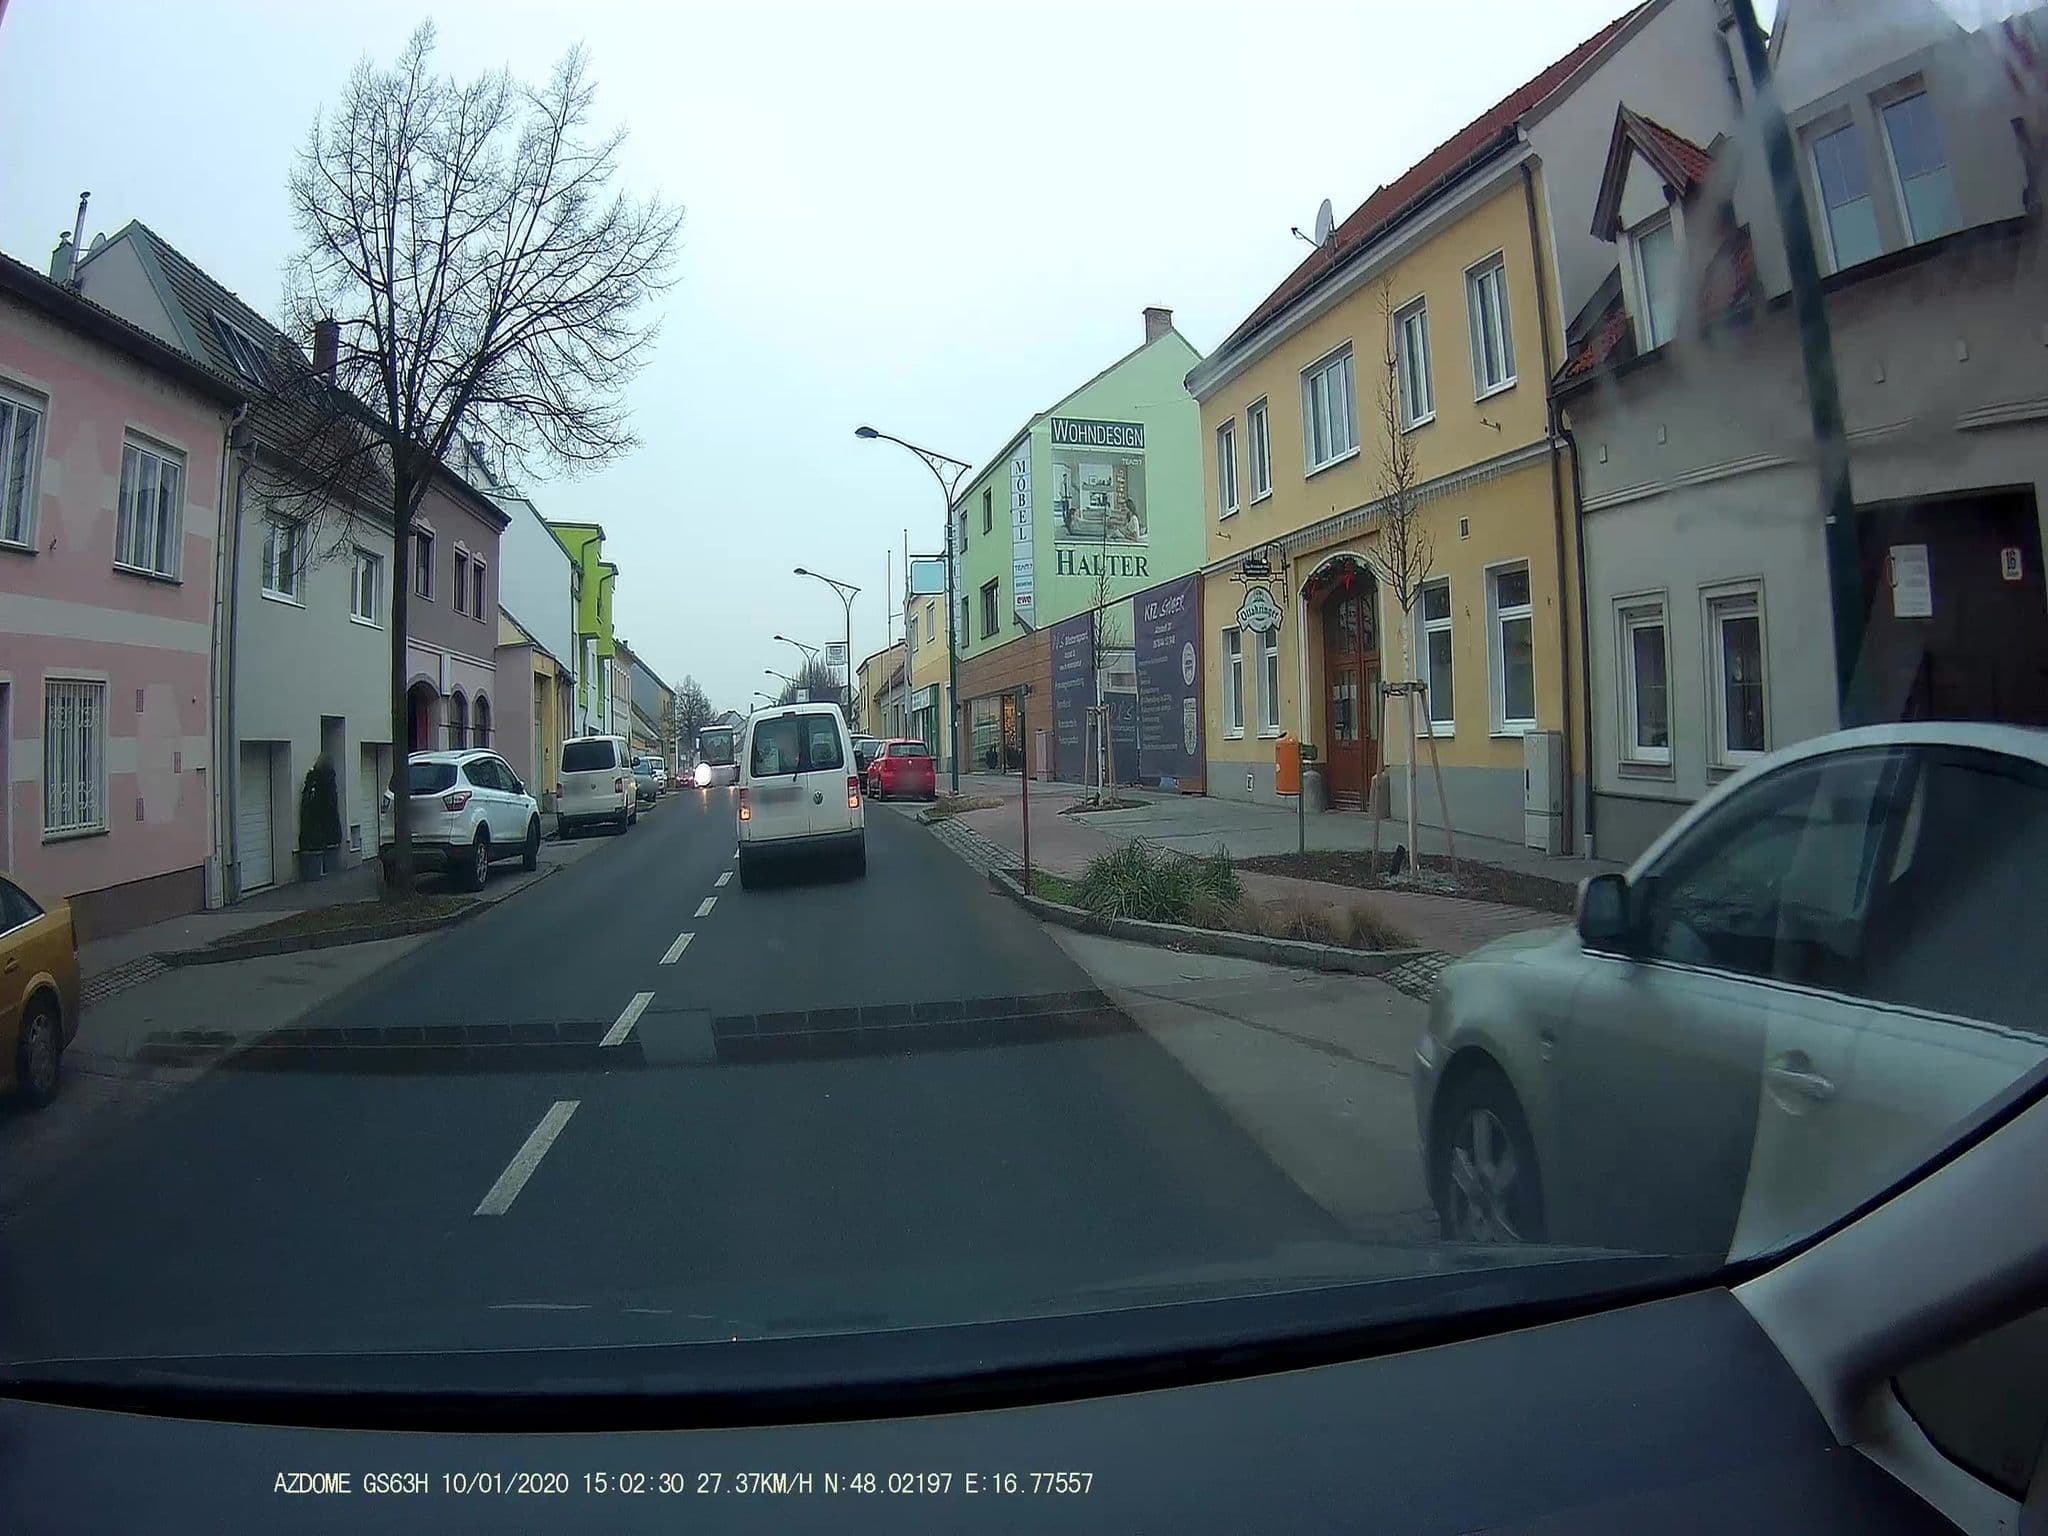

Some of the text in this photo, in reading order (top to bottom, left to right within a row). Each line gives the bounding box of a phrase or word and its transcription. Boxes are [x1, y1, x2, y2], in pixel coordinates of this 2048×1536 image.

[1052, 419, 1144, 447] WOHNDESIGN
[1014, 461, 1028, 541] MÖBEL
[1055, 549, 1149, 577] HALTER
